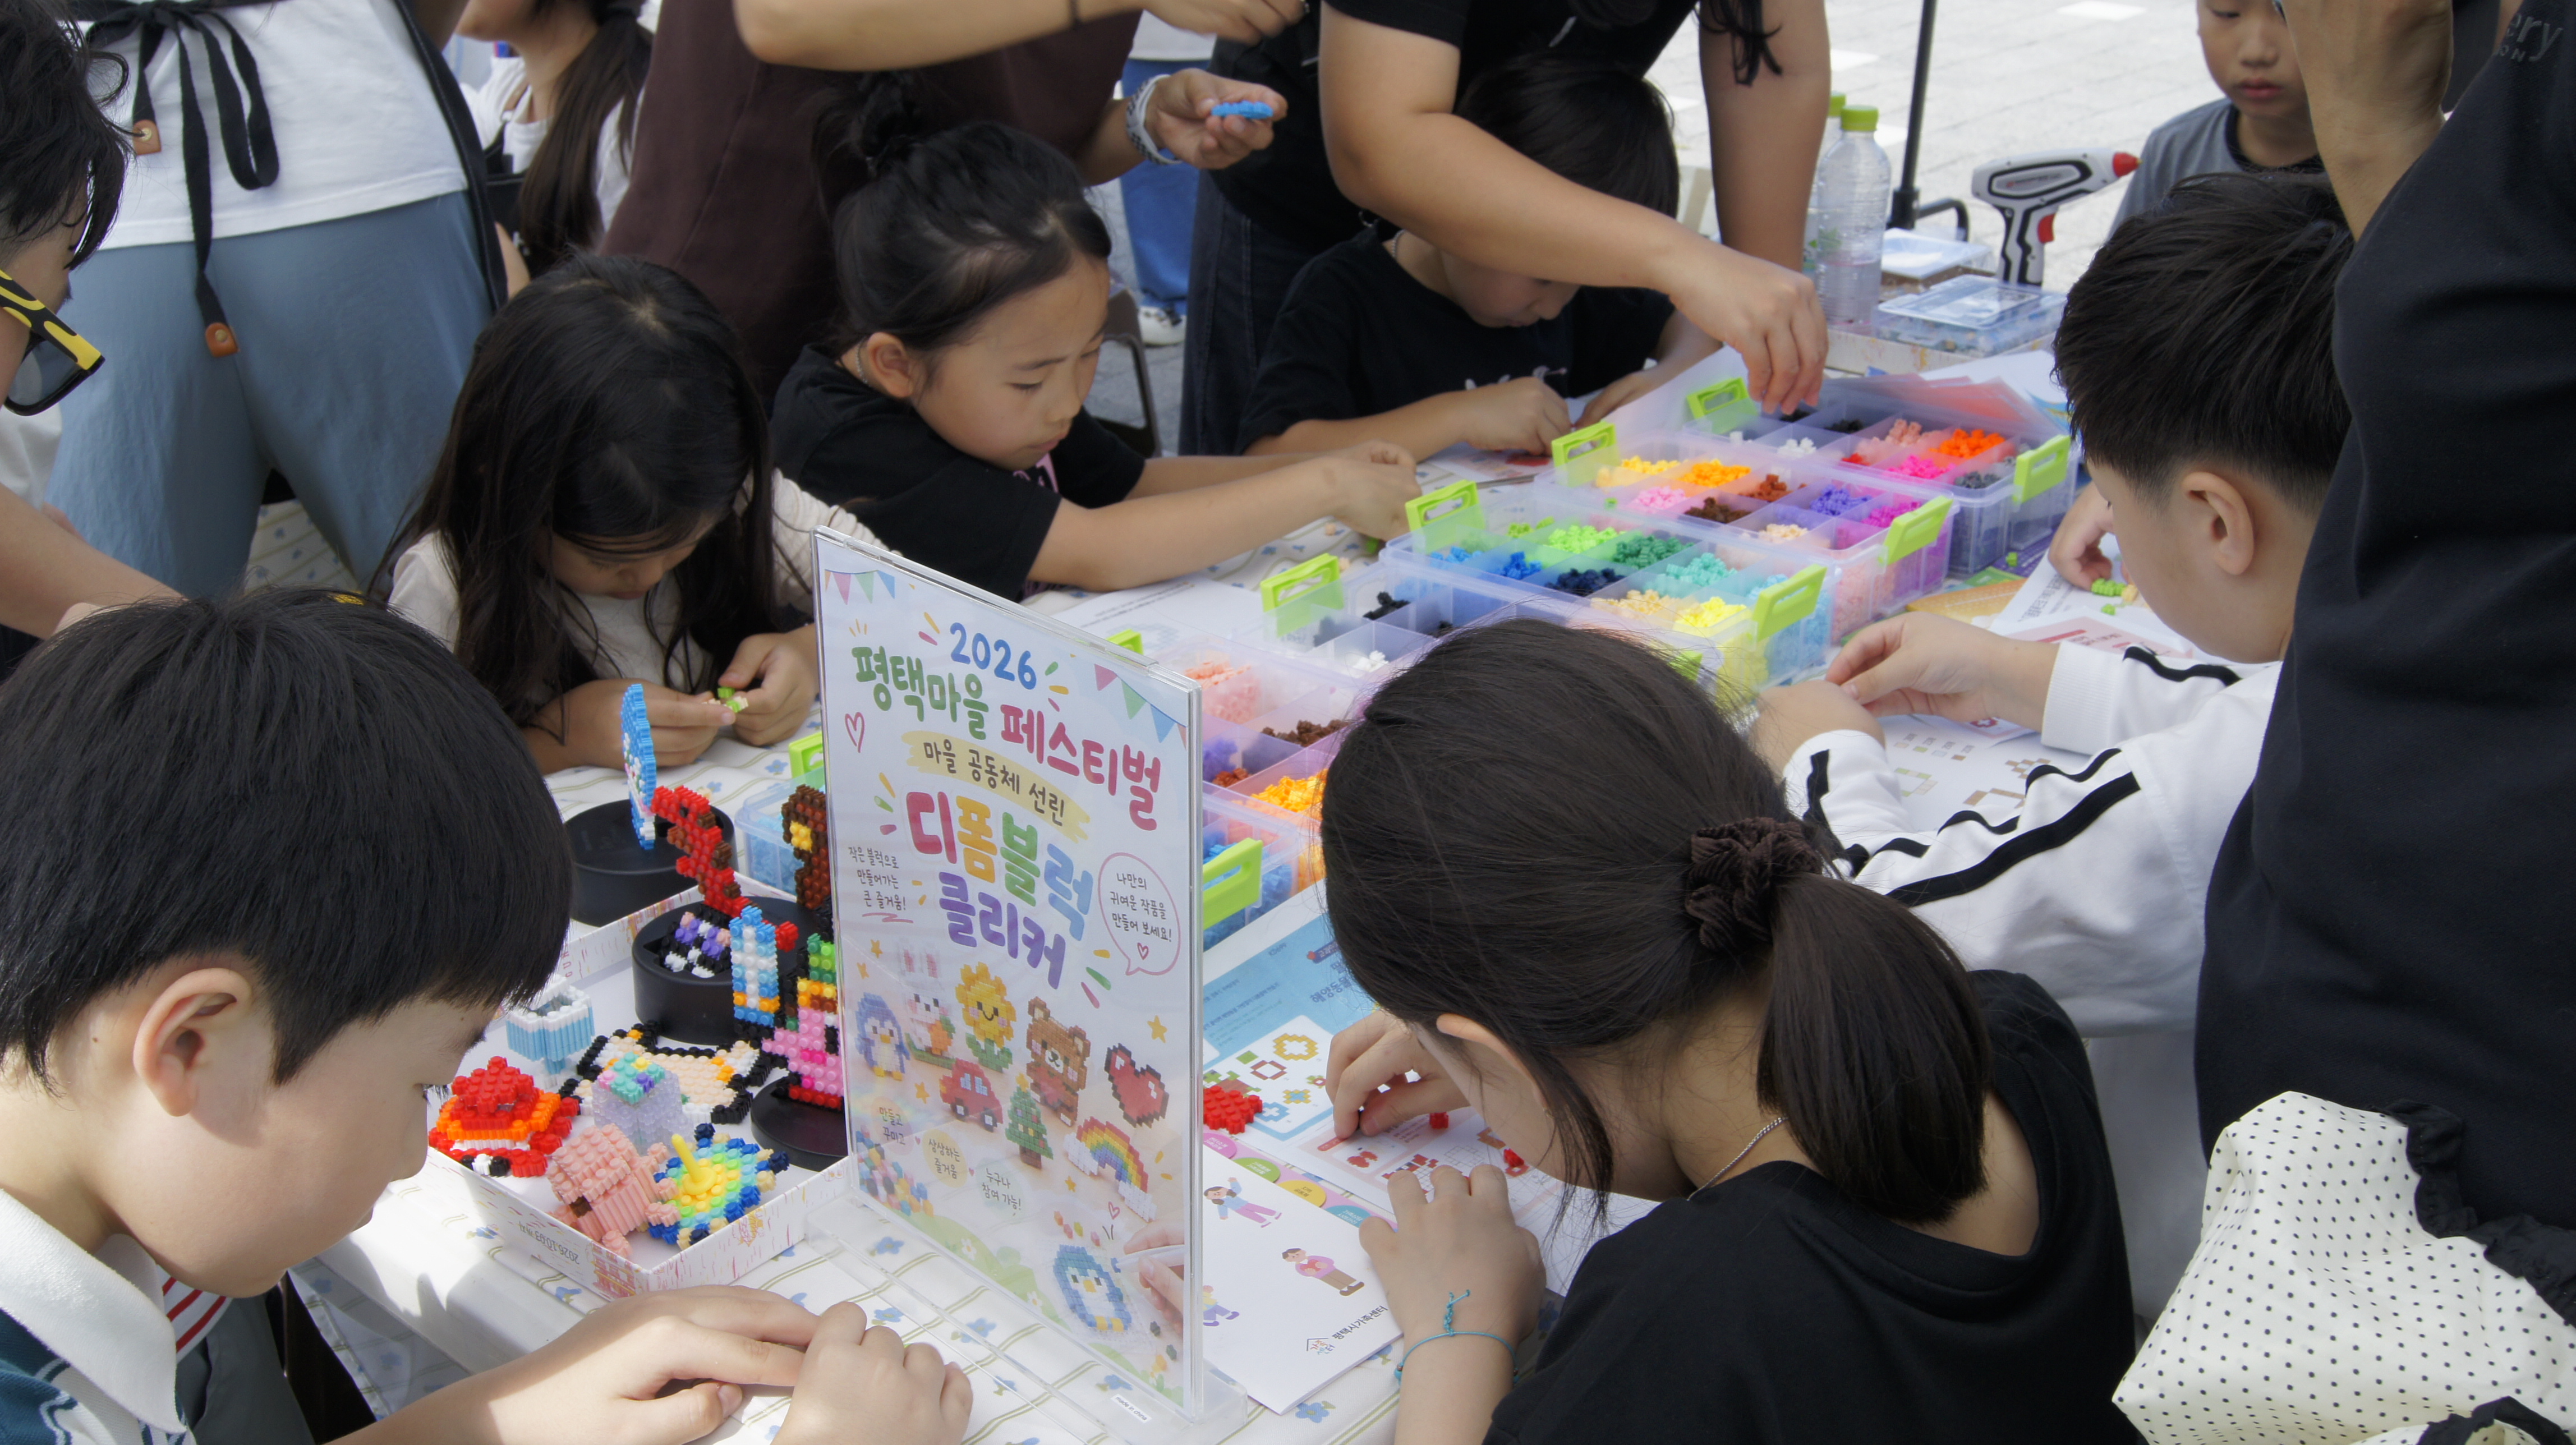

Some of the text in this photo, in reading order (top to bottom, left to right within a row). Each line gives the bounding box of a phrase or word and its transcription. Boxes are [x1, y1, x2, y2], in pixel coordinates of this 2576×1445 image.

[950, 622, 1037, 690] 2026
[851, 646, 1161, 831] 평택마을 페스티벌
[923, 739, 1065, 827] 마을 공동체 선린
[848, 846, 900, 869] 작은 블럭으로
[905, 791, 1094, 942] 디폼블럭
[857, 869, 900, 890] 만들어가는
[1116, 873, 1147, 890] 나만의
[863, 890, 907, 912] 큰 즐거움!
[1110, 891, 1167, 920] 귀여운 작품을
[939, 871, 1066, 990] 클리커
[1111, 913, 1172, 943] 만들어 보세요!
[878, 1106, 904, 1127] 만들고
[882, 1126, 906, 1146] 꾸미고
[928, 1138, 961, 1163] 상상하는
[933, 1157, 958, 1180] 즐거움
[985, 1167, 1011, 1189] 누구나
[981, 1182, 1022, 1211] 참여 가능!
[1331, 1305, 1389, 1340] 평택시가족센터
[1115, 1396, 1130, 1407] made
